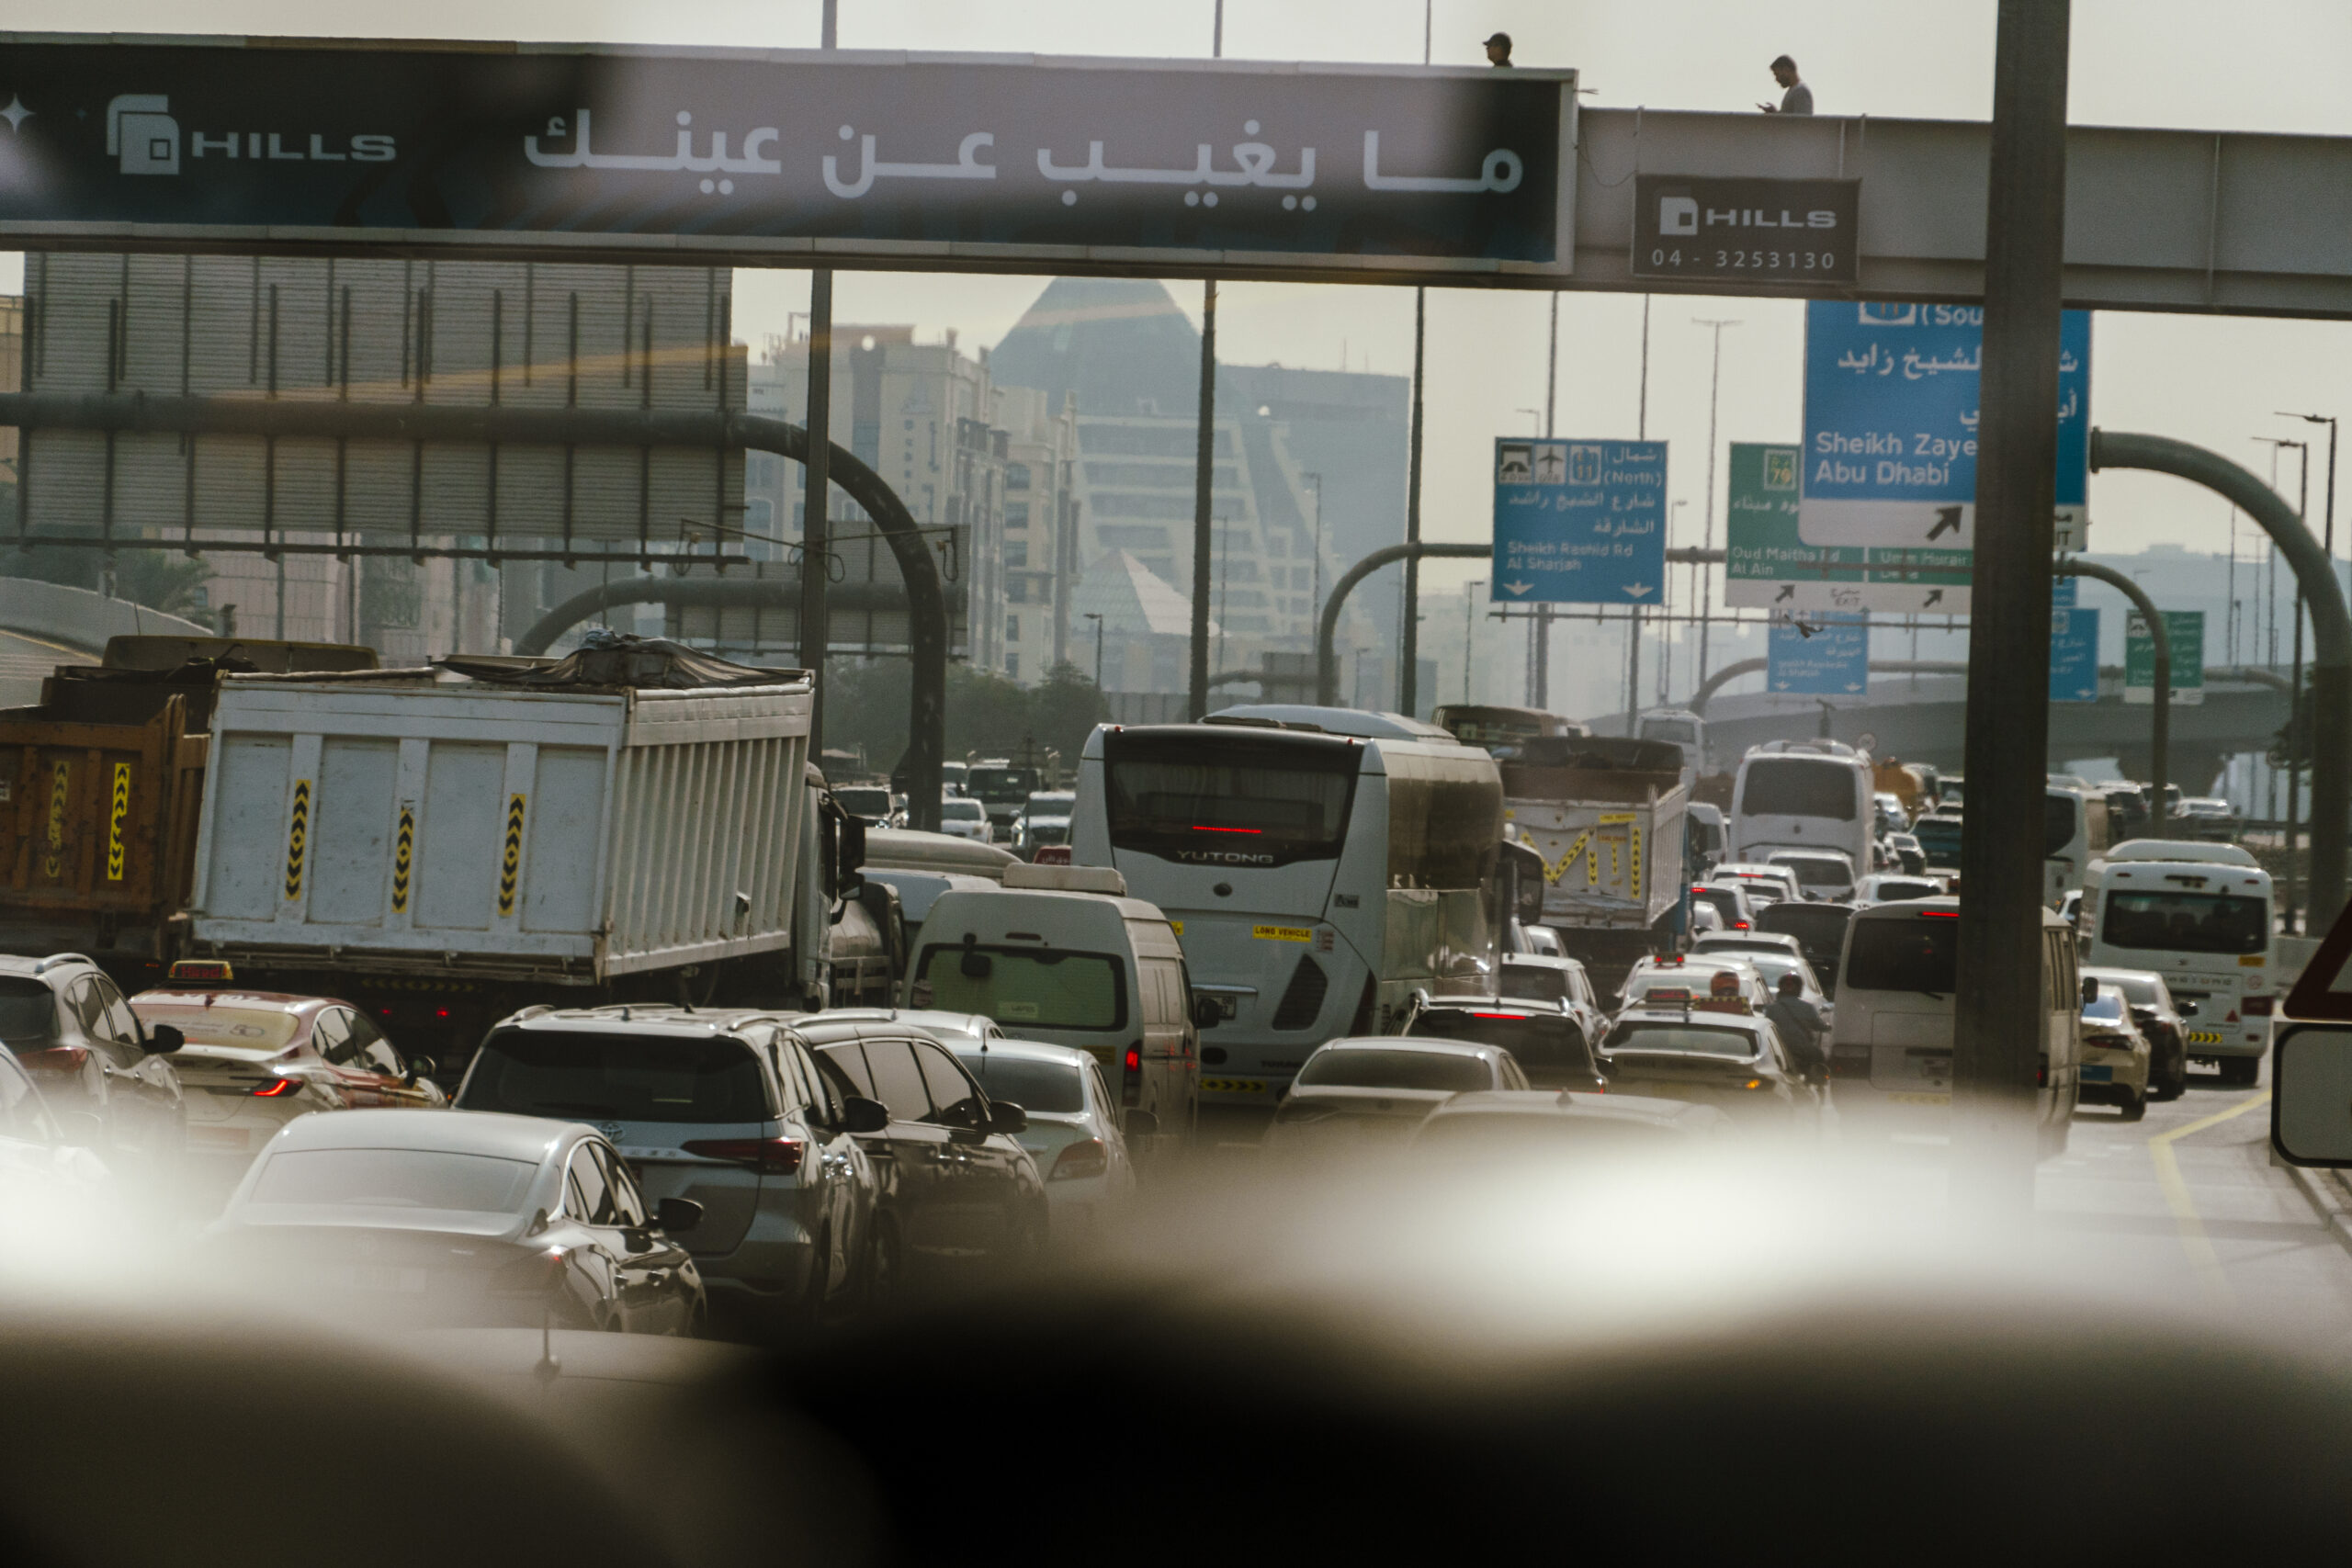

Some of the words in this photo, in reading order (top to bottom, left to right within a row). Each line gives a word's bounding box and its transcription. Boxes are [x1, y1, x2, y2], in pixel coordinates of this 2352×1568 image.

[192, 131, 396, 162] HILLS
[525, 109, 781, 195] عينك
[822, 125, 996, 198] عن
[1036, 119, 1316, 211] يغيب
[1363, 130, 1523, 194] ما
[1706, 209, 1837, 229] HILLS
[1652, 249, 1682, 266] 04
[1716, 251, 1835, 268] 3253130
[1922, 304, 1984, 325] (Sou
[1838, 343, 1894, 376] زايد
[1903, 344, 1982, 379] لشيخ
[1816, 431, 1903, 455] Sheikh
[1915, 434, 1978, 460] Zaye
[1815, 459, 1866, 483] Abu
[1876, 460, 1949, 486] Dhabi
[1614, 543, 1634, 556] Rd
[1733, 547, 1761, 559] Oud
[1731, 562, 1747, 574] Al
[1751, 562, 1774, 576] Ain
[1177, 851, 1273, 863] YUTONG
